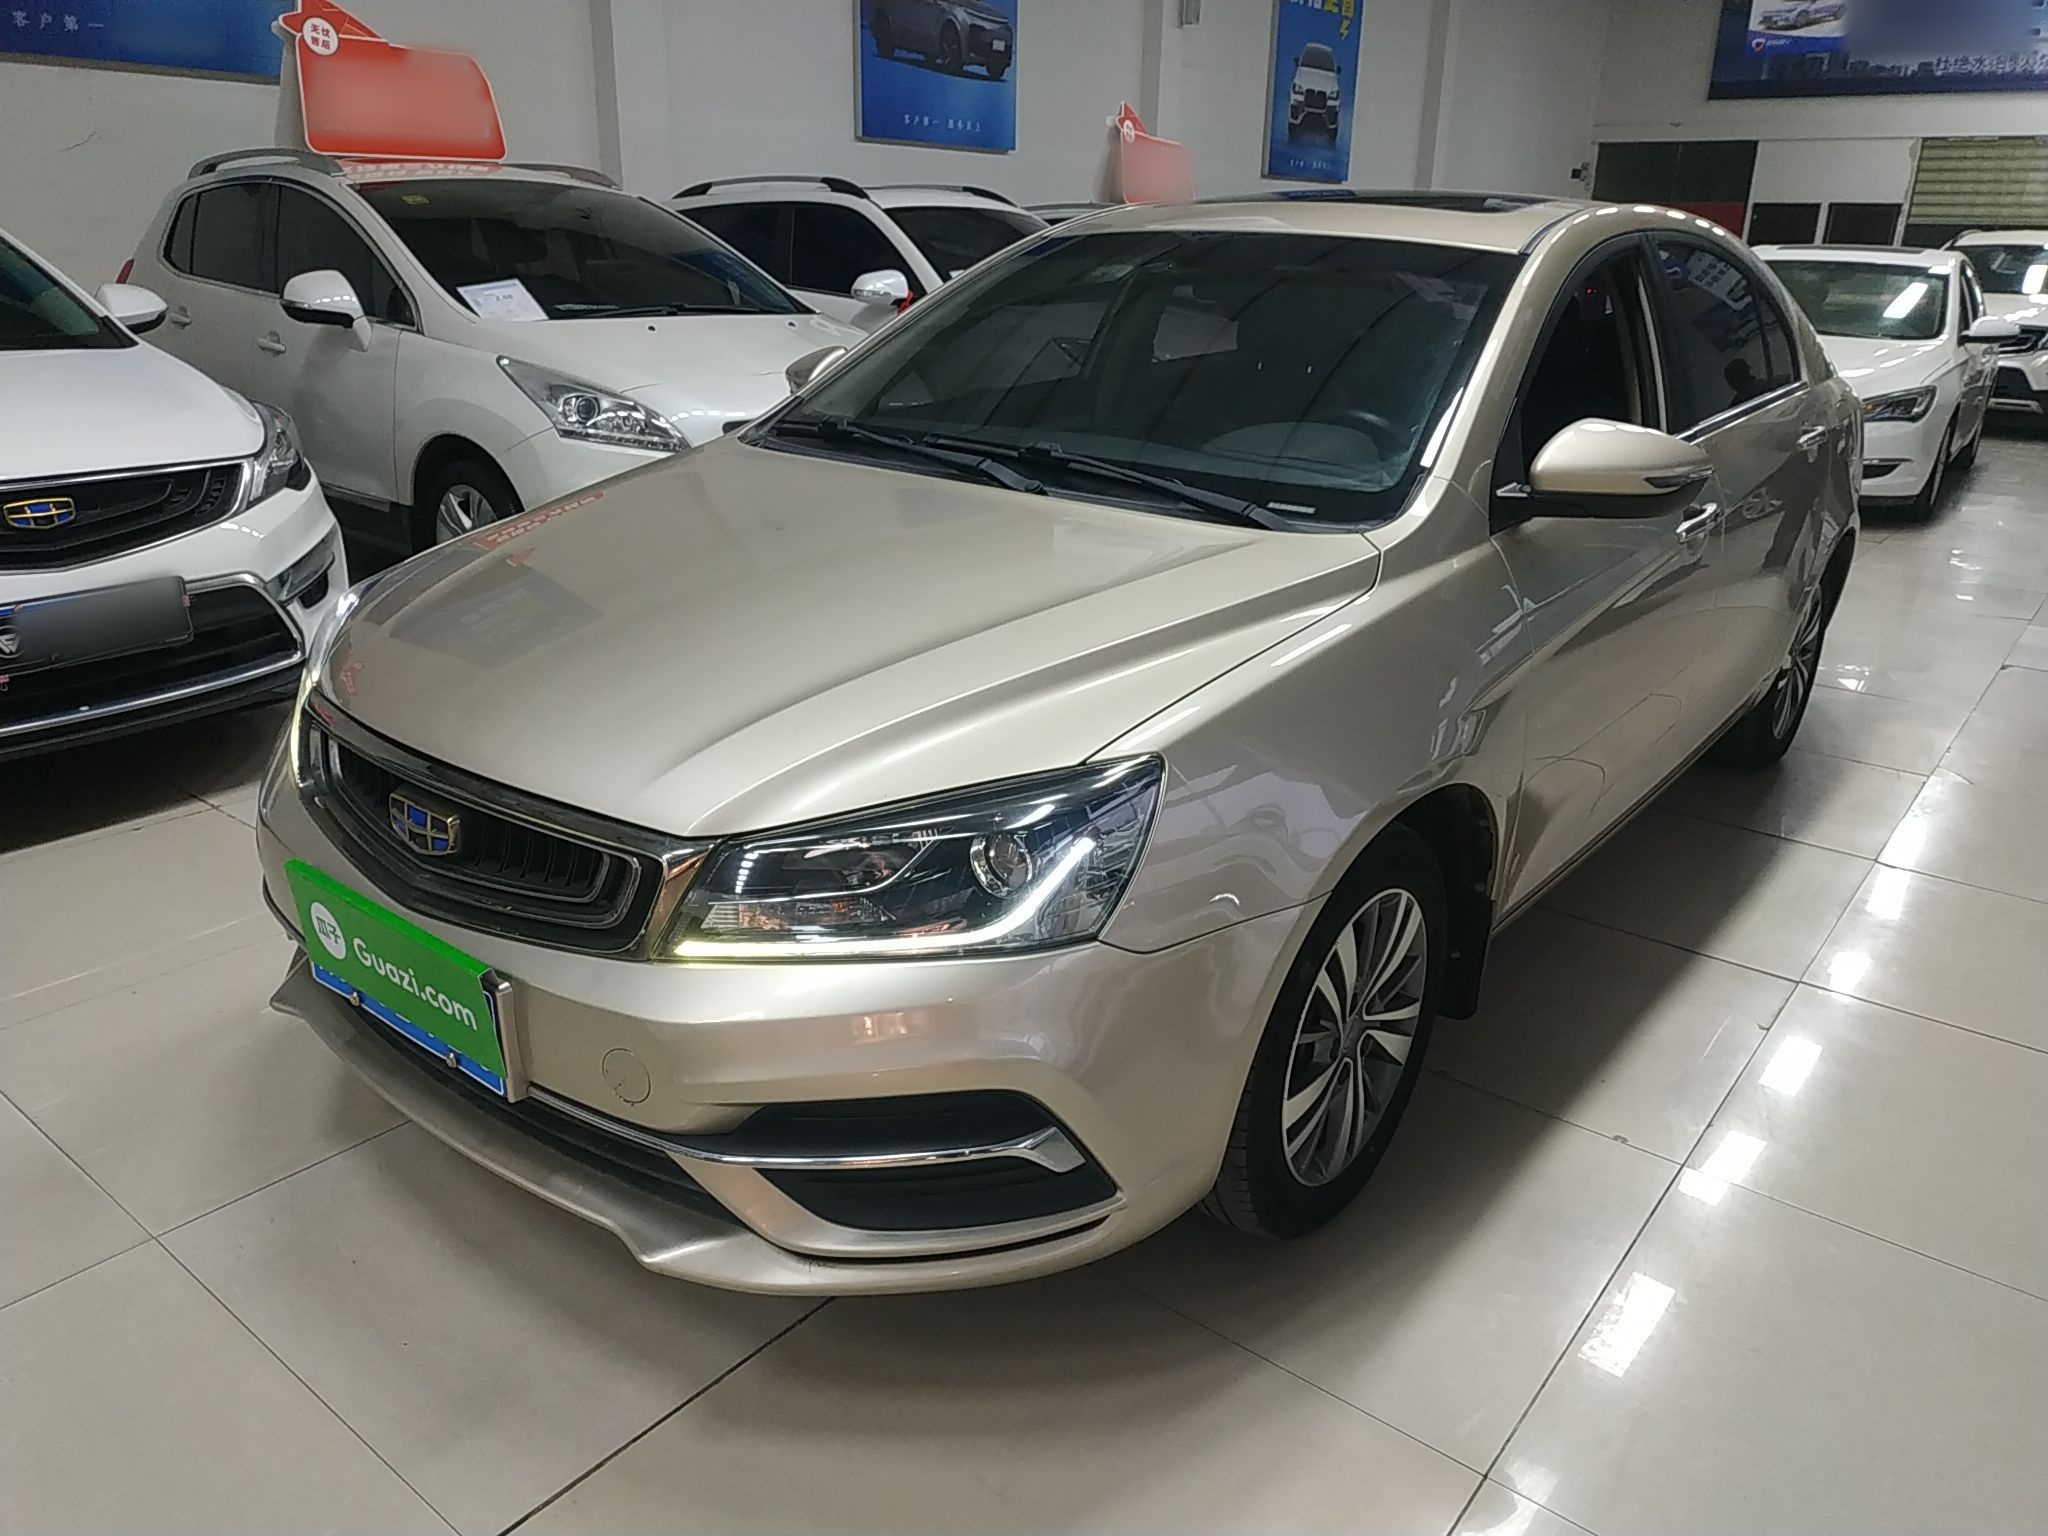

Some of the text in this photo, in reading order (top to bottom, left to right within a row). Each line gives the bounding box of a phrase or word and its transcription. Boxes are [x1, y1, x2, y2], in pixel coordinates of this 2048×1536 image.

[11, 10, 104, 32] 客户第一
[316, 915, 341, 945] 瓜子
[353, 937, 478, 1031] Guazi.com
